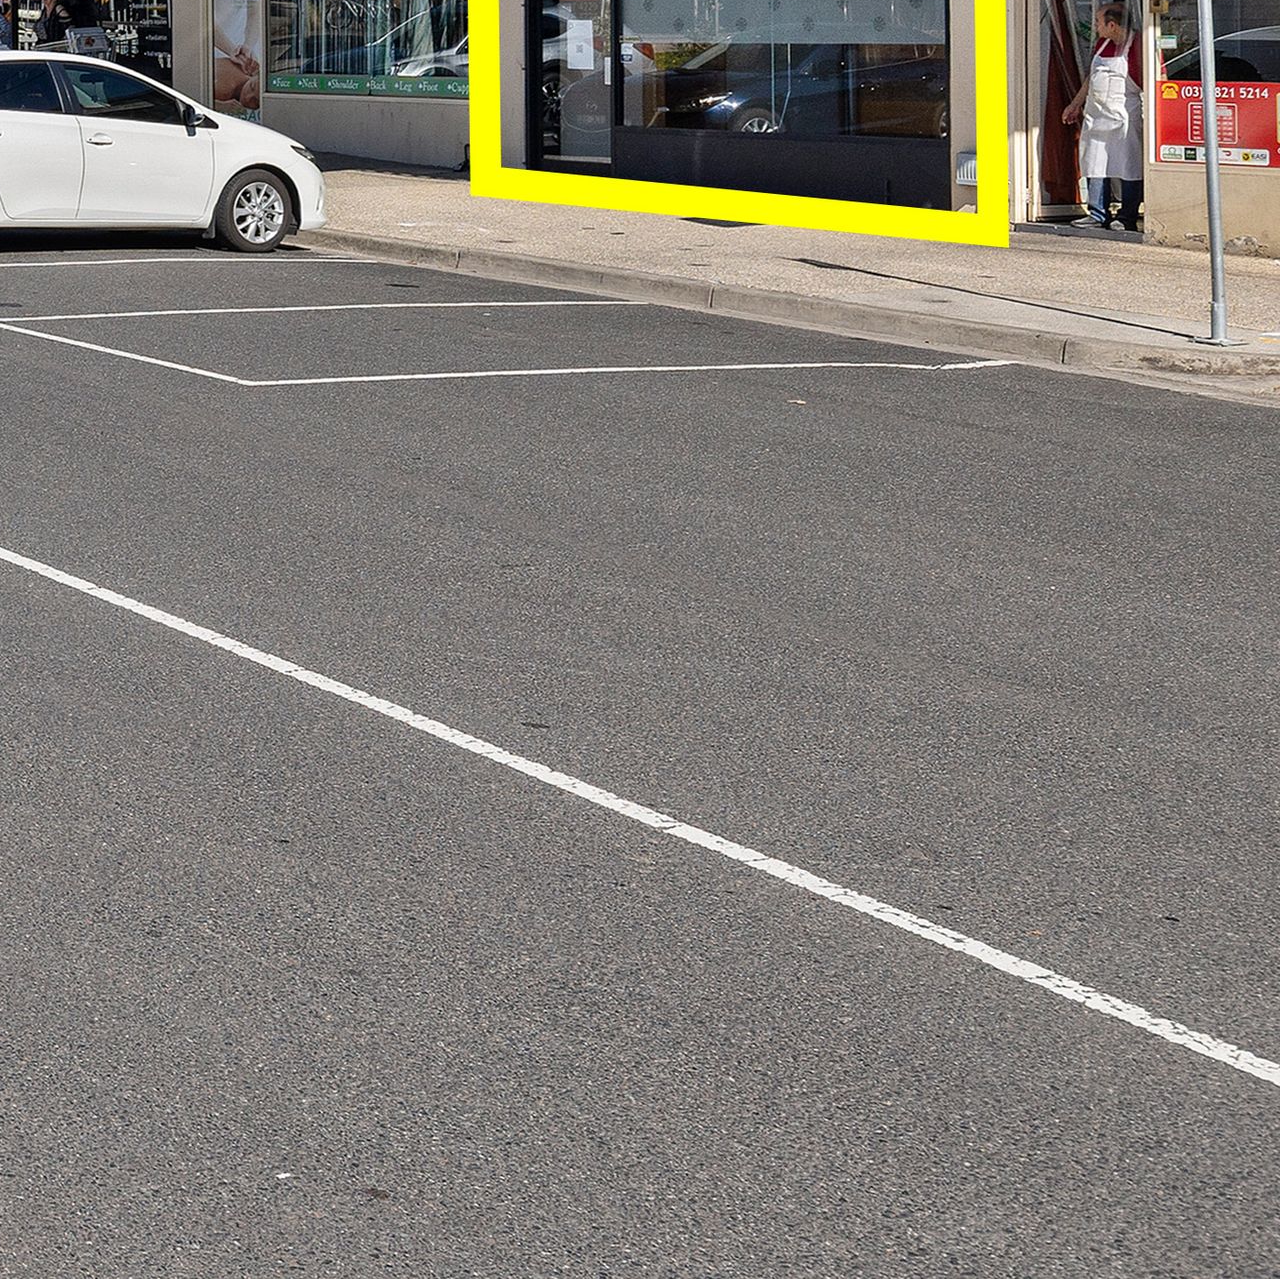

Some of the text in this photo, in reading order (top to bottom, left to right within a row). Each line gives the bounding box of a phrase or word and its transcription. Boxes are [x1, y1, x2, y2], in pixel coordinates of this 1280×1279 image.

[331, 79, 359, 90] Shoulder
[369, 80, 386, 90] Back
[422, 81, 438, 91] Foot
[1215, 87, 1235, 98] 821
[1239, 87, 1269, 99] 5214
